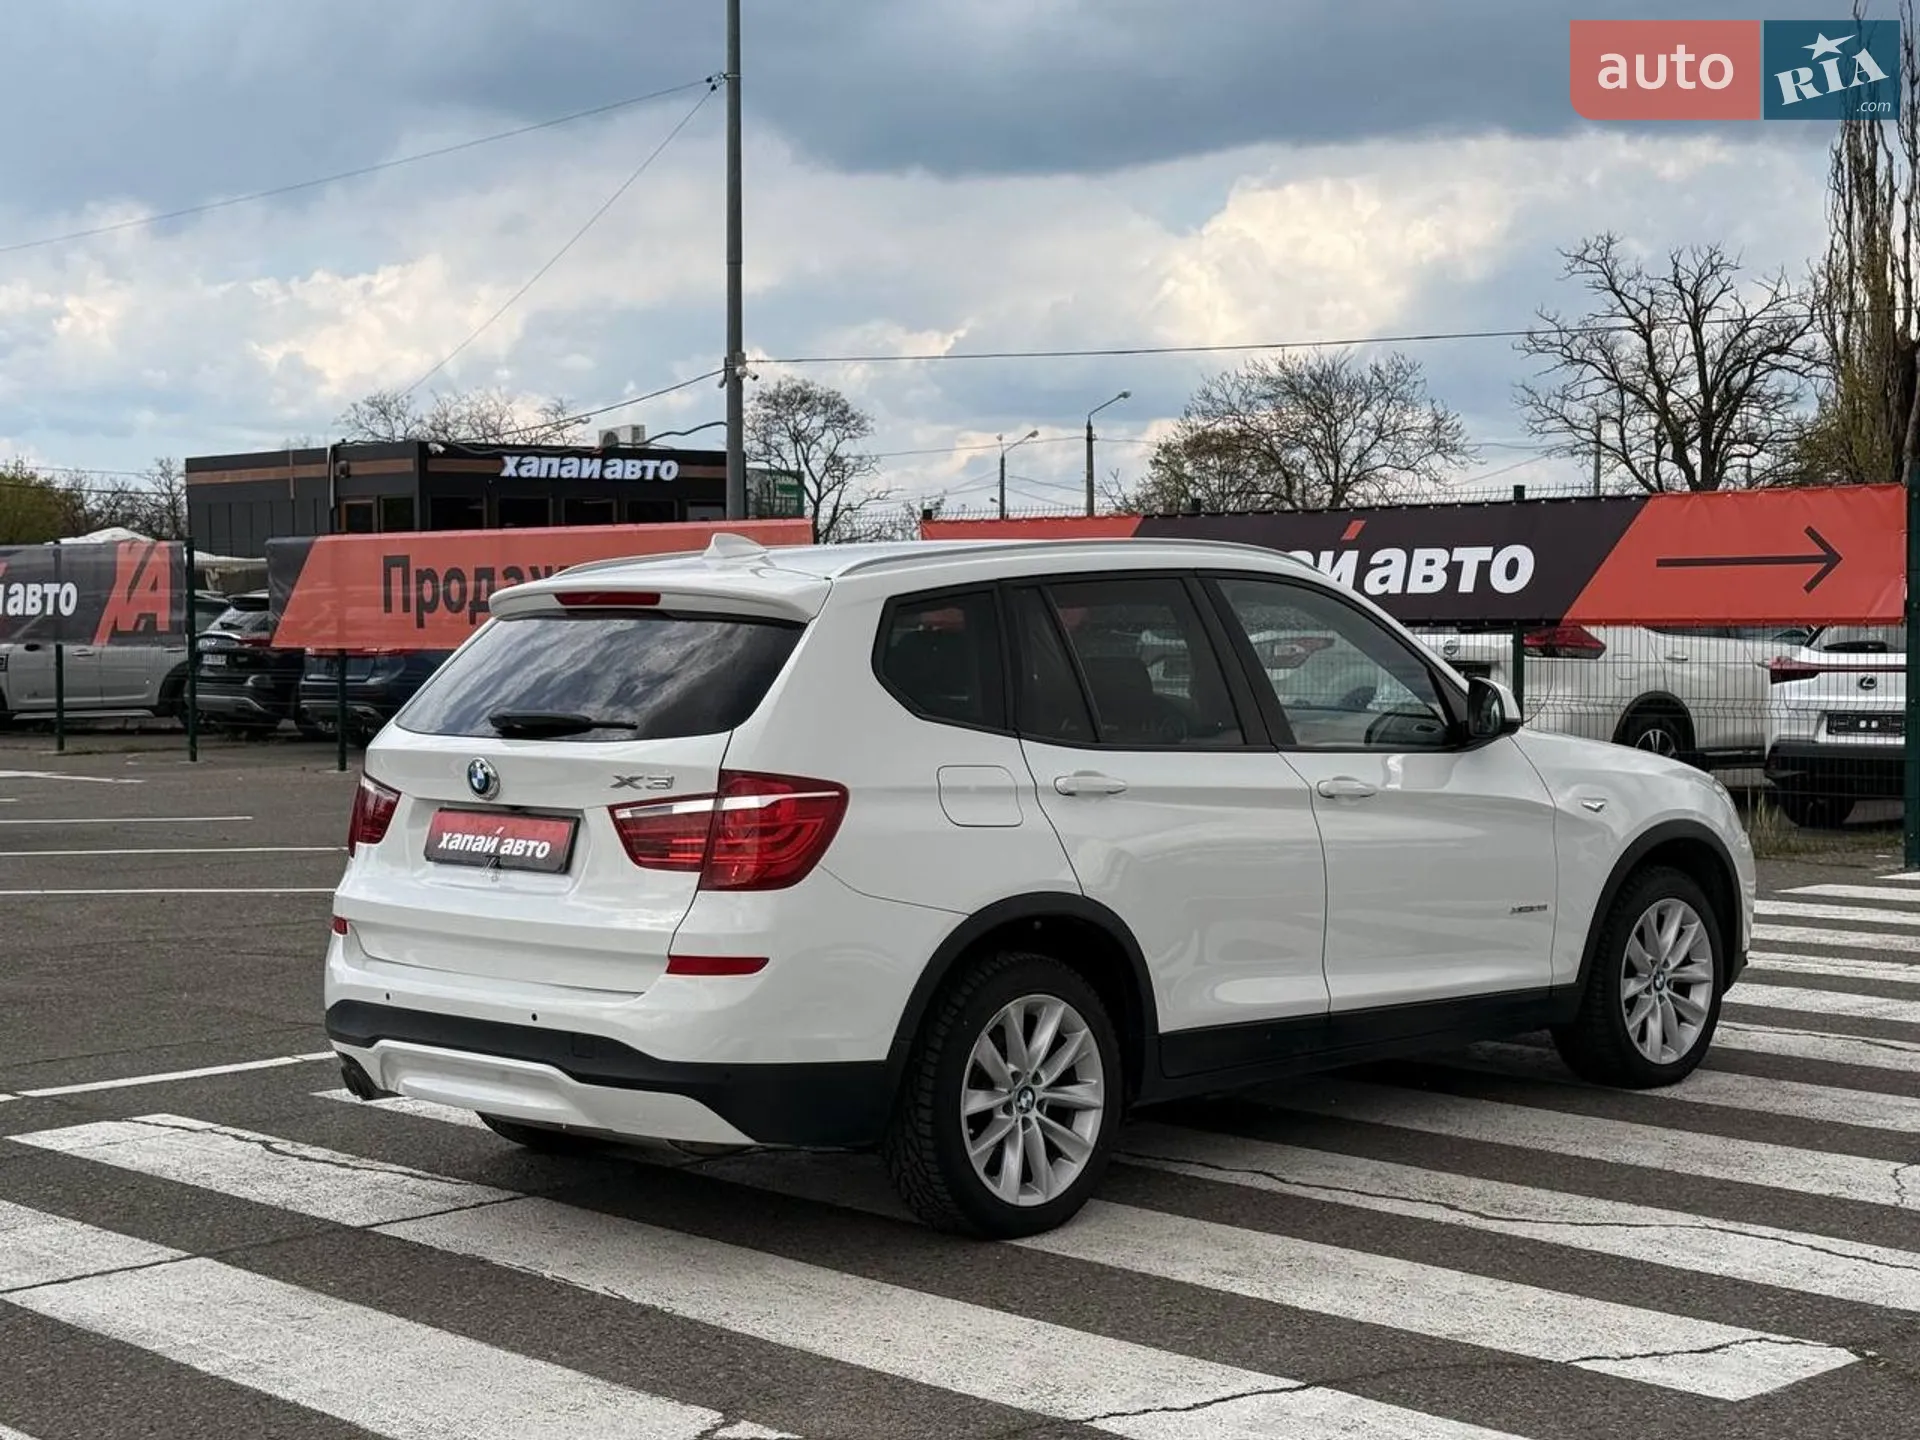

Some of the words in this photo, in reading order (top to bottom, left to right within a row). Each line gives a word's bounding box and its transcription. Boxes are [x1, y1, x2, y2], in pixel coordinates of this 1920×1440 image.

[602, 458, 679, 481] авто
[1363, 545, 1535, 596] авто
[6, 582, 78, 617] авто
[609, 775, 675, 790] X3
[438, 827, 504, 853] хапай
[500, 837, 551, 860] авто
